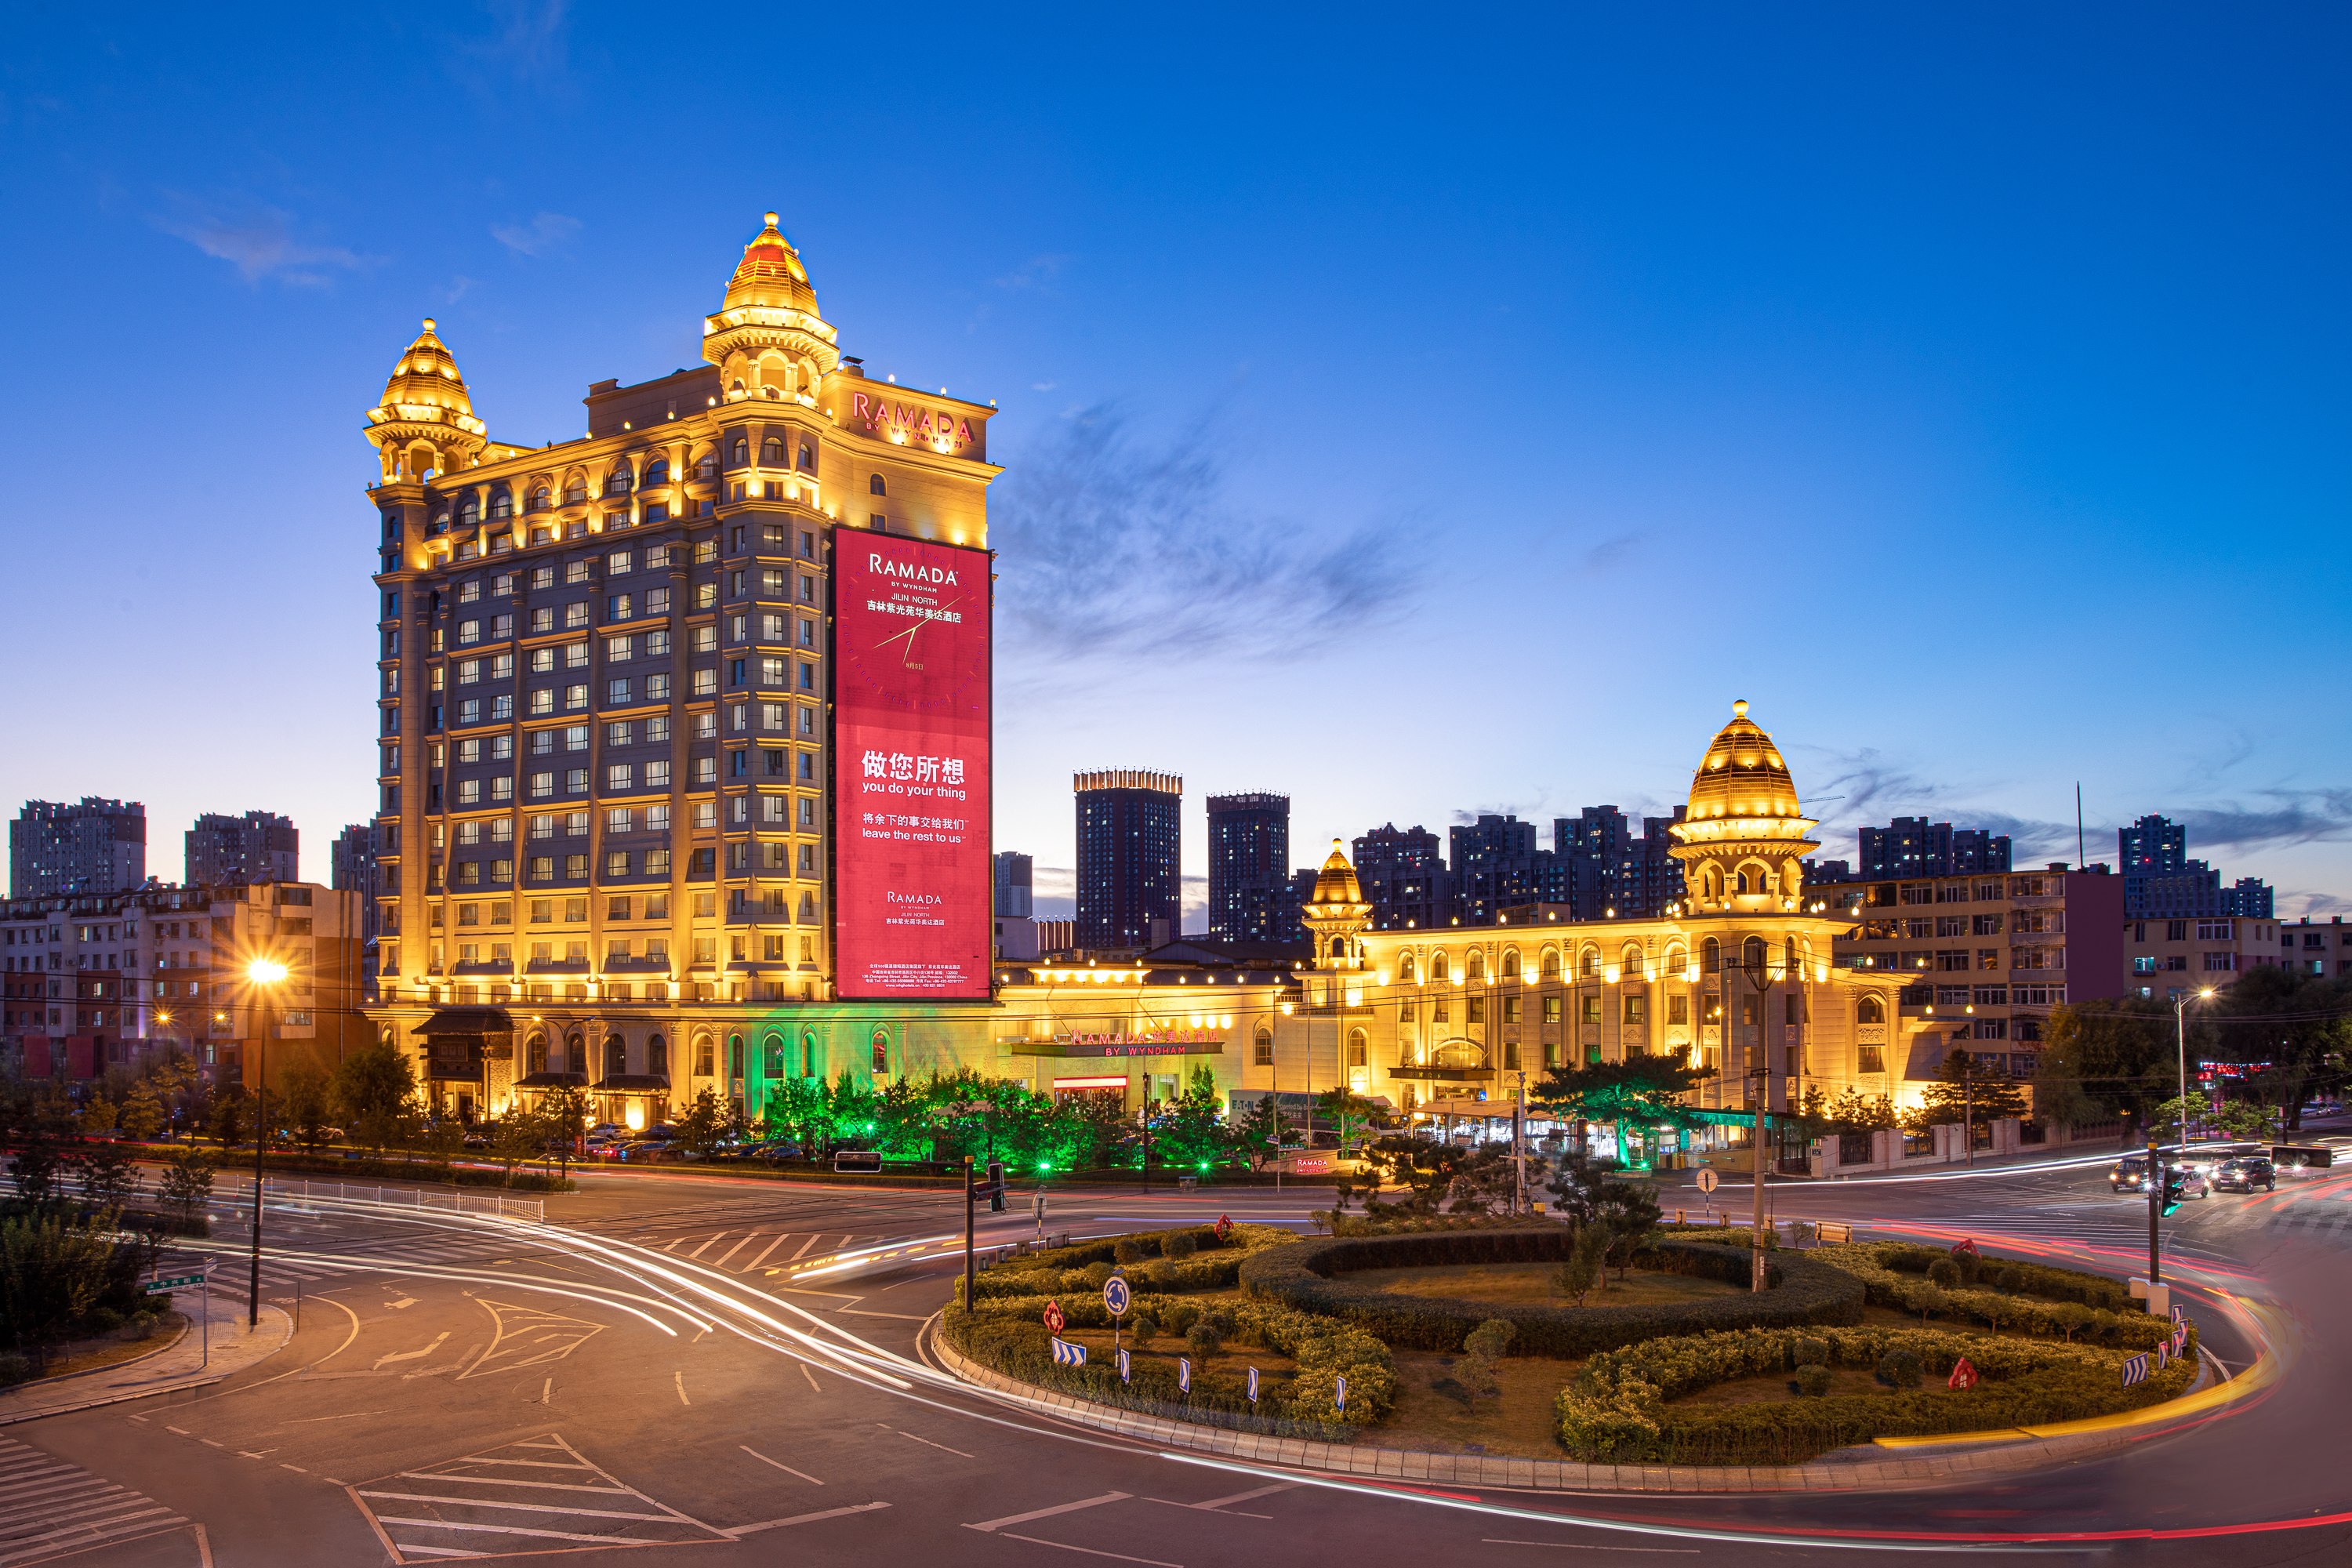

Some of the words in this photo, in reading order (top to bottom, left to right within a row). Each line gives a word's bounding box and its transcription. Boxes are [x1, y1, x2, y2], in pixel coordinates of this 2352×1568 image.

[853, 392, 972, 442] RAMADA
[866, 423, 880, 431] BY
[891, 426, 961, 448] WYNDHAM
[869, 554, 956, 586] RAMADA
[903, 583, 937, 593] WYNDHAM
[913, 596, 938, 606] NORTH
[867, 600, 961, 623] 吉林紫光苑华美达酒店
[862, 750, 964, 785] 做您所想
[862, 782, 884, 793] you
[888, 782, 903, 793] do
[907, 786, 933, 797] your
[937, 786, 966, 800] thing
[862, 812, 964, 830] 将余下的事交给我们
[862, 828, 890, 839] leave
[894, 829, 910, 840] the
[913, 833, 933, 842] rest
[936, 833, 946, 842] to
[887, 891, 942, 904] RAMADA
[1073, 1029, 1146, 1045] RAMADA
[1151, 1029, 1218, 1043] 华美达酒店
[1105, 1047, 1120, 1056] BY
[1128, 1046, 1185, 1056] WYNDHAM
[1297, 1103, 1302, 1112] by
[160, 1278, 191, 1287] 中兴街
